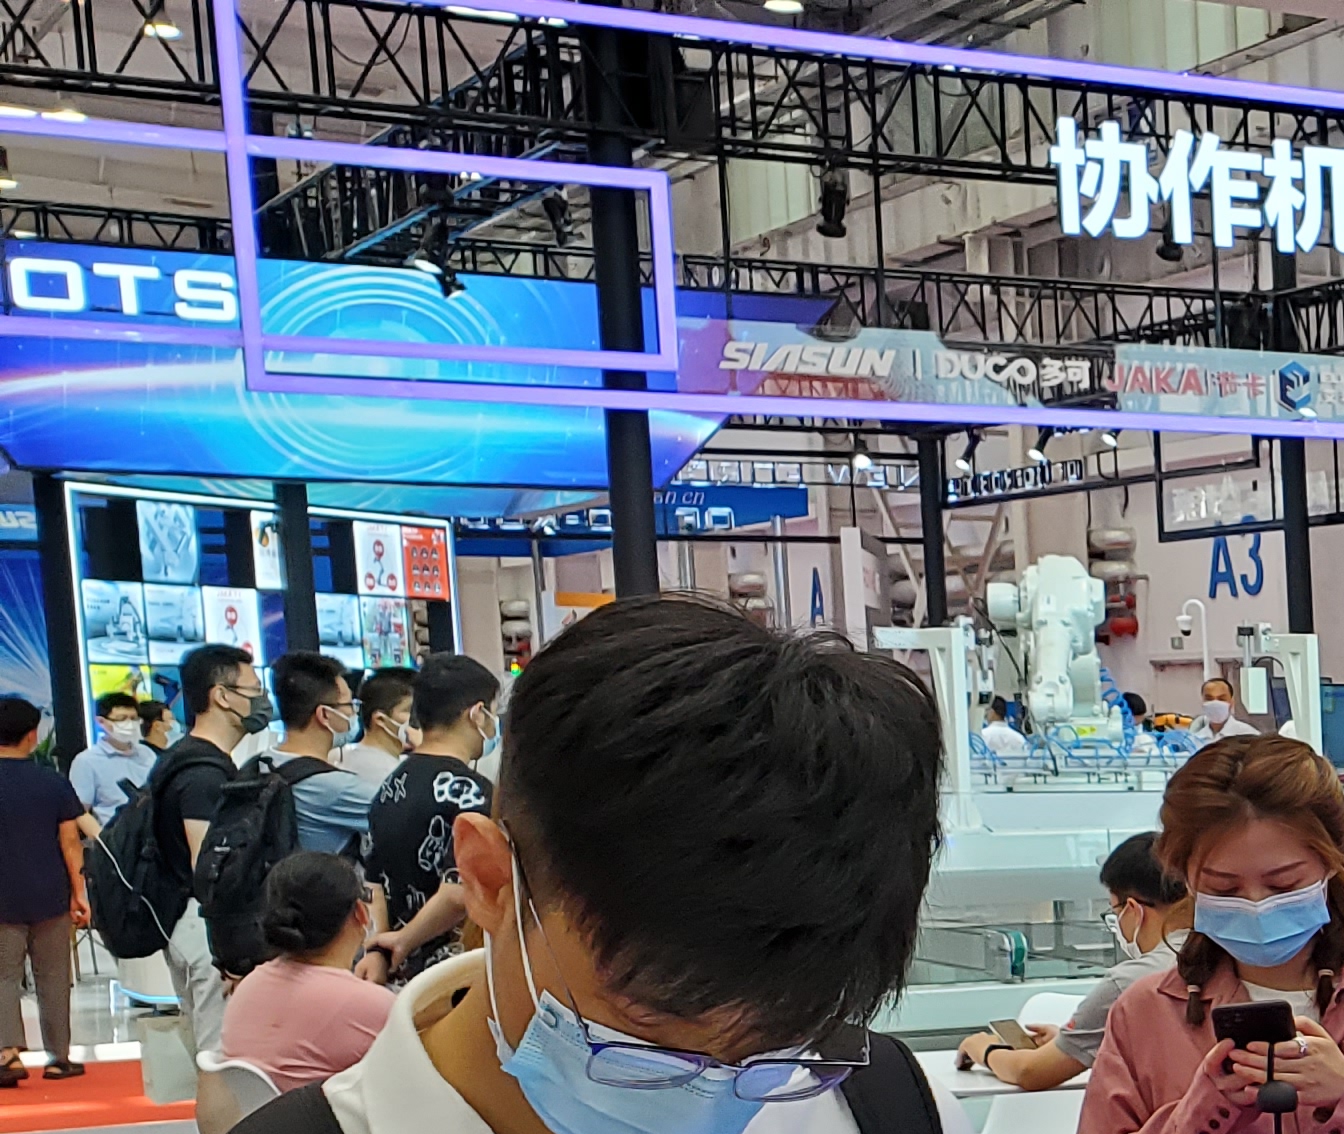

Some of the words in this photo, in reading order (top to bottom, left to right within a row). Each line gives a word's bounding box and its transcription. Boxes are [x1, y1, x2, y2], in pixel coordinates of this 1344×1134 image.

[718, 341, 896, 378] SIASUN
[1105, 361, 1205, 397] JAKA
[1208, 514, 1264, 599] A3
